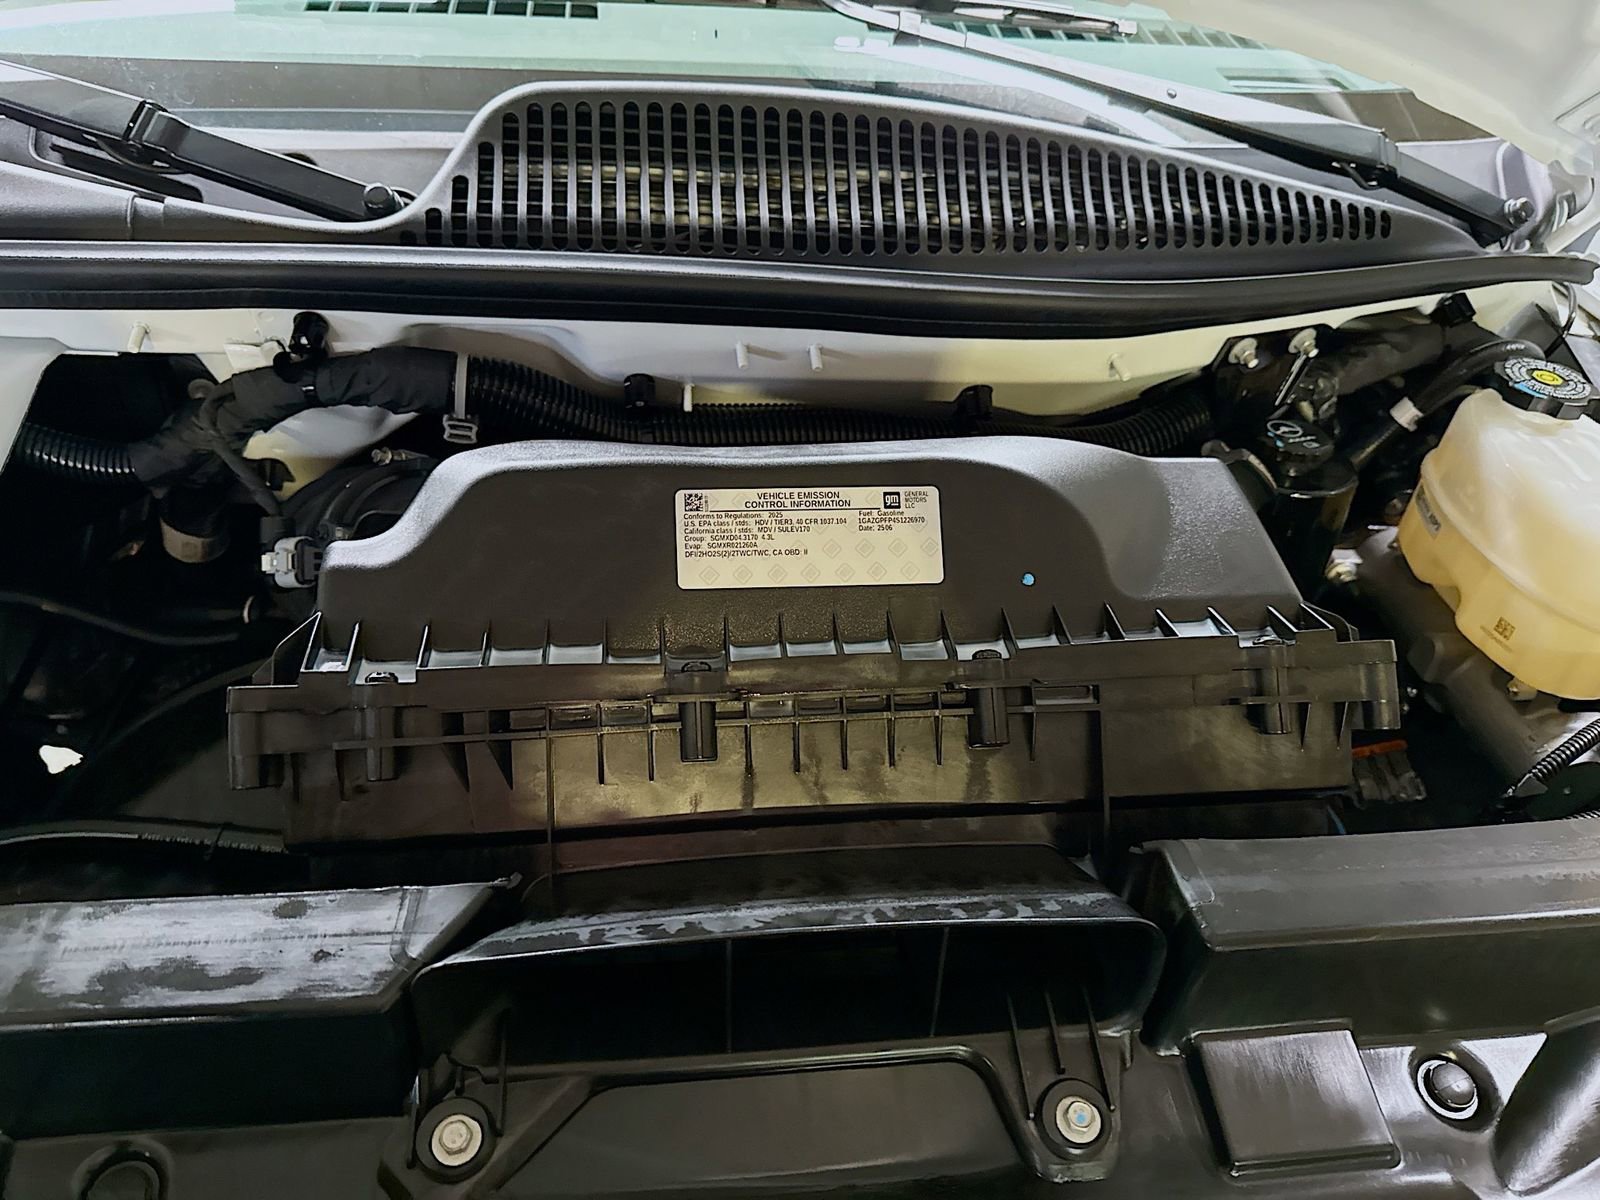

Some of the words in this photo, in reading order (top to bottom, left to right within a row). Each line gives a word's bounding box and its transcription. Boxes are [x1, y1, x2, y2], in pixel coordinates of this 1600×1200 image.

[797, 491, 840, 499] EMISSION
[744, 500, 788, 508] CONTROL
[790, 499, 851, 508] INFORMATION
[885, 495, 899, 506] gm
[724, 512, 765, 520] Regulations:
[820, 517, 847, 525] 1037.104
[684, 527, 715, 535] California
[684, 535, 706, 543] Group:
[684, 543, 702, 551] Evap:
